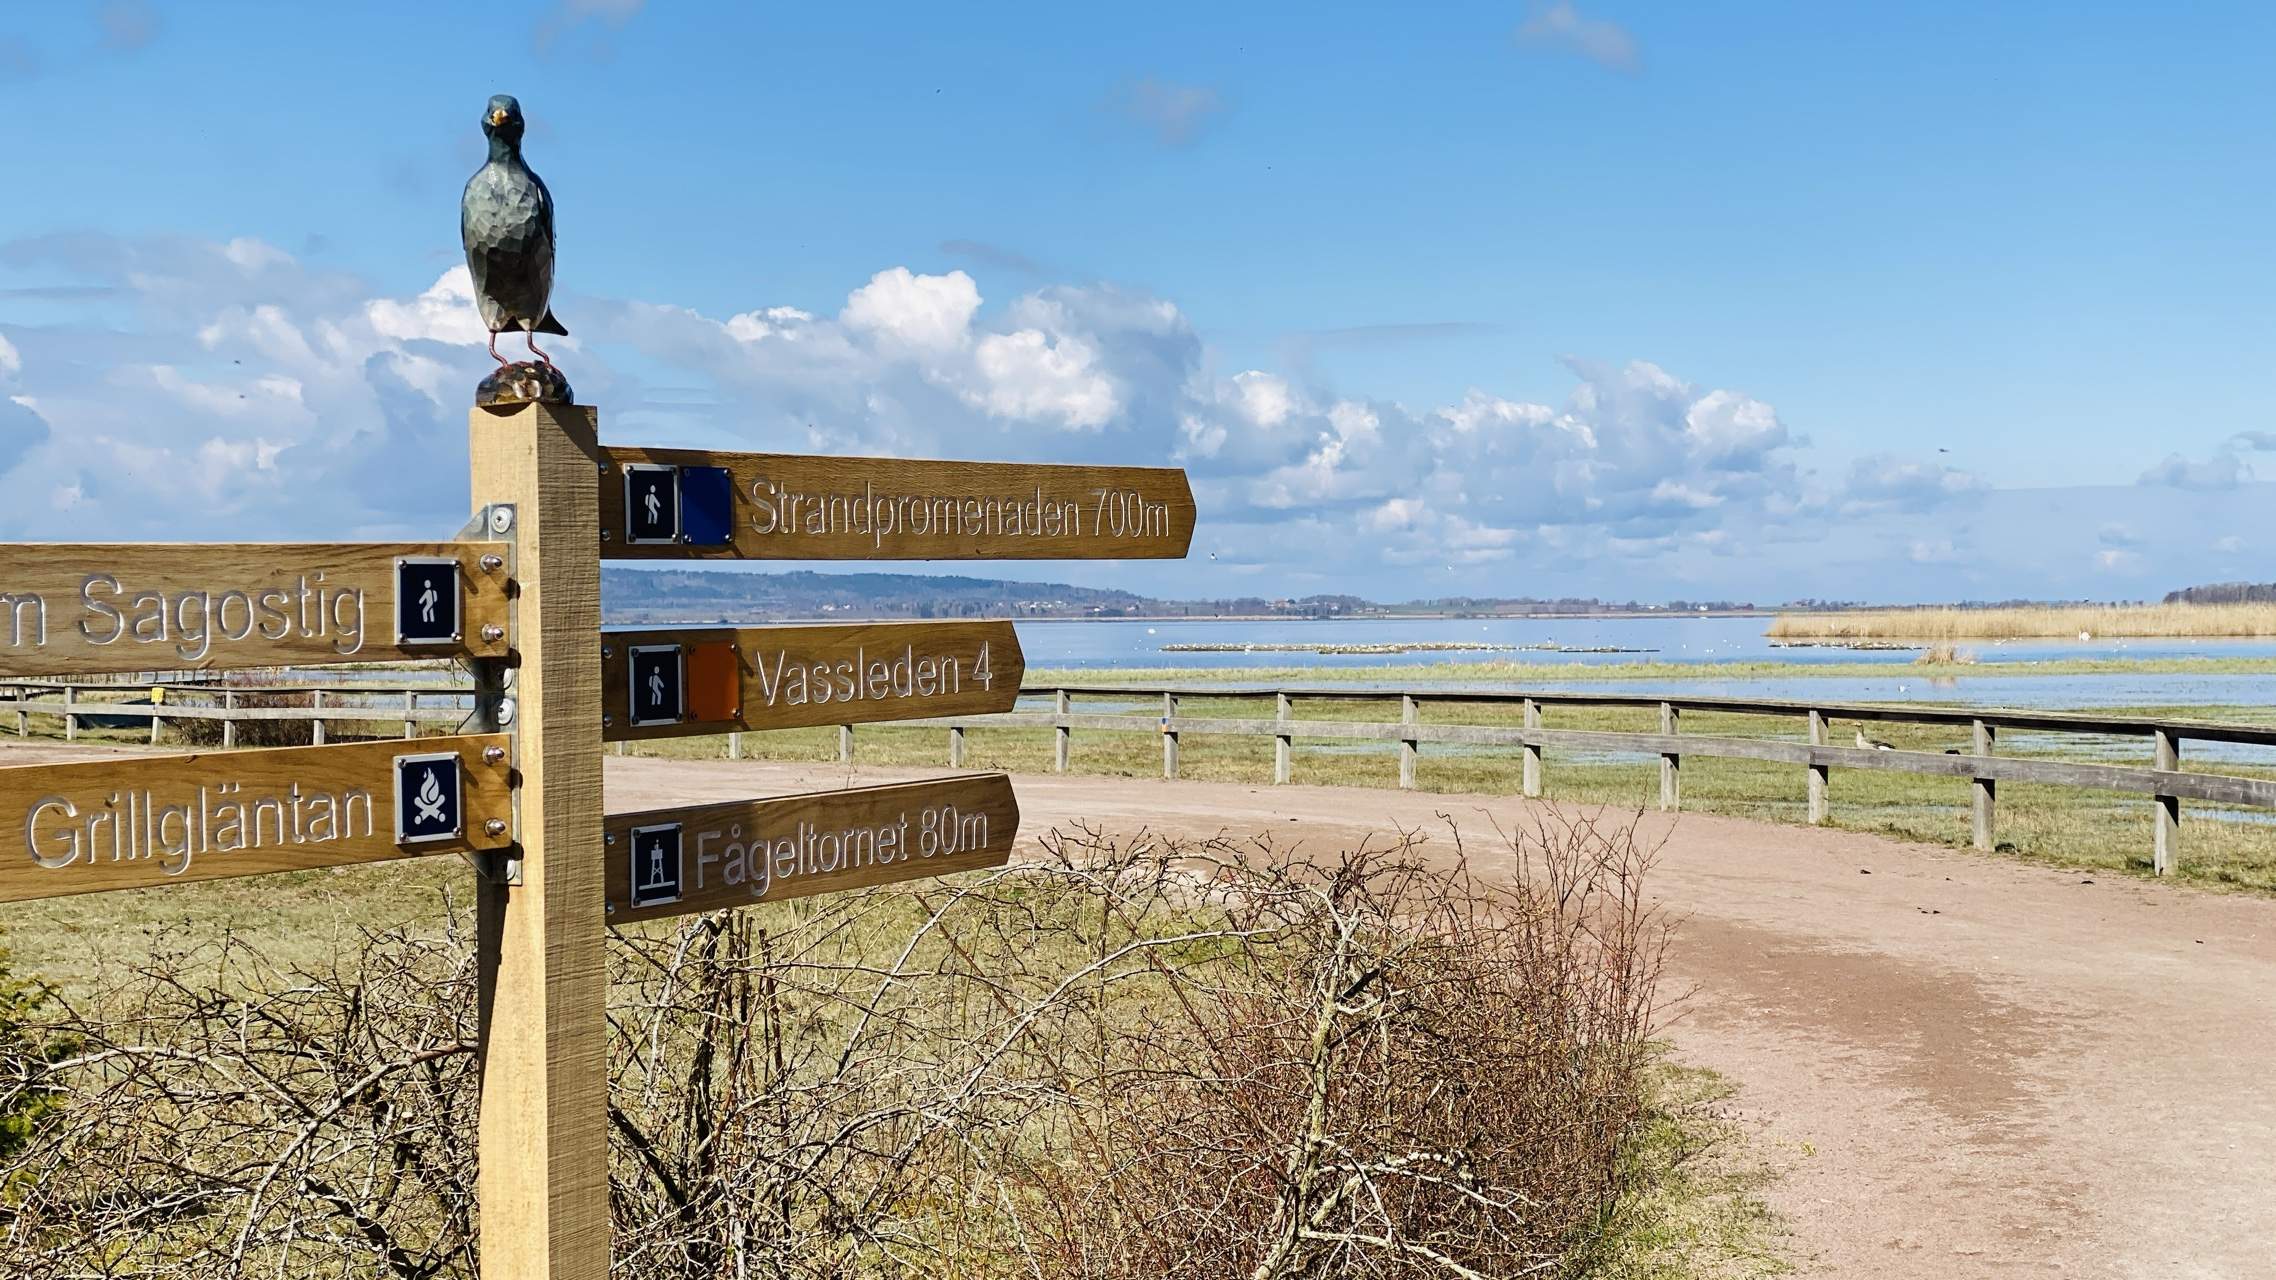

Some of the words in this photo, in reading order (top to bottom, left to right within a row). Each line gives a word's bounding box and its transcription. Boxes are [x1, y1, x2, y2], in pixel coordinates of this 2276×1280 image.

[751, 479, 1080, 548] Strandpromenaden
[1090, 488, 1169, 538] 700m
[79, 572, 364, 660] Sagostig
[756, 644, 960, 706] Vassleden
[973, 641, 993, 691] 4
[28, 782, 374, 875] Grillgläntan
[698, 812, 908, 897] Fågeltornet
[920, 805, 987, 858] 80m
